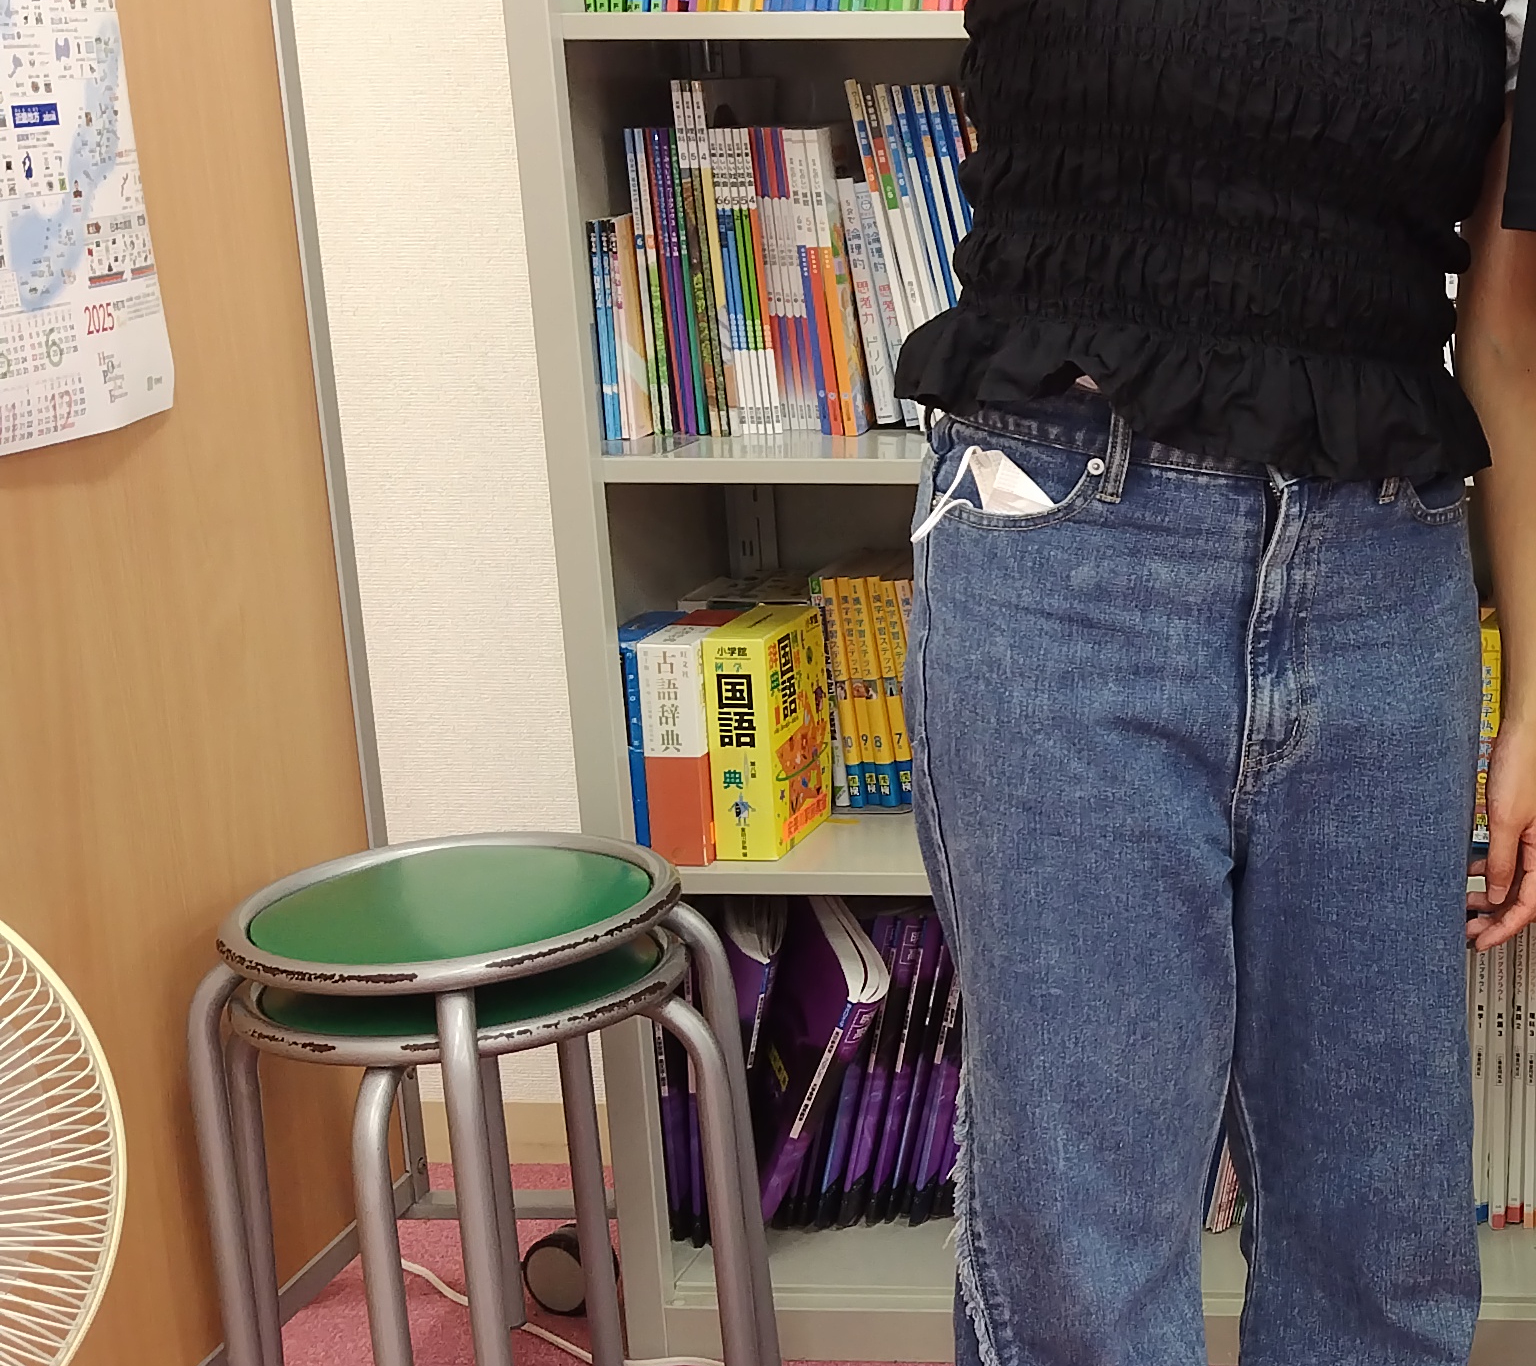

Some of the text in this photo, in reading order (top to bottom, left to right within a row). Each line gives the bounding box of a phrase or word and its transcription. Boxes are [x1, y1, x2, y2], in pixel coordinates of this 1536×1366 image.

[681, 152, 687, 161] 6
[691, 152, 697, 161] 5
[701, 152, 707, 161] 4
[716, 196, 723, 205] 6
[724, 196, 731, 205] 6
[733, 196, 739, 205] 5
[741, 196, 748, 205] 5
[749, 196, 756, 204] 4
[848, 228, 866, 271] 論理的
[84, 302, 115, 336] 2025
[856, 280, 875, 326] 思考力
[45, 326, 63, 368] 6
[865, 336, 885, 377] ドリル
[50, 389, 76, 431] 12
[716, 647, 748, 657] 小学館
[825, 597, 844, 676] 漢字学習ステップ
[841, 595, 858, 676] 漢字学習ステップ
[852, 596, 872, 676] 漢字学習ステップ
[872, 594, 893, 675] 漢字学習ステップ
[777, 632, 798, 721] 国語
[652, 650, 683, 753] 古語辞典
[716, 673, 757, 749] 国語
[1496, 1012, 1504, 1037] 英語3
[1528, 1012, 1536, 1037] 理科3
